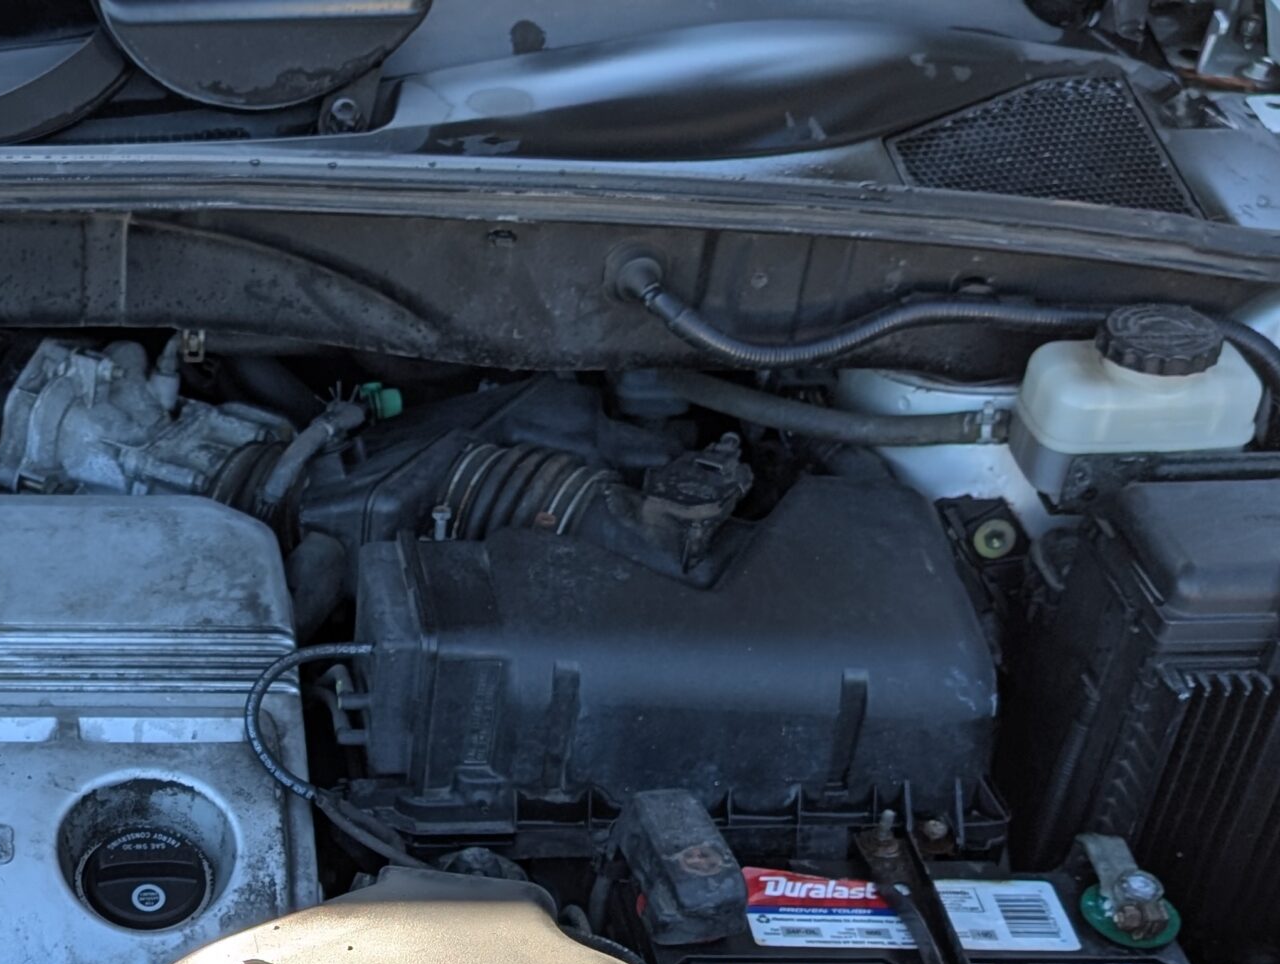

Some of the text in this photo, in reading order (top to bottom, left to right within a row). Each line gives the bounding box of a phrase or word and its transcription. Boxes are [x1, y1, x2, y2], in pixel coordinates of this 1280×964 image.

[152, 833, 181, 849] ENERGY
[759, 876, 878, 899] Duralast
[778, 906, 874, 915] PROVEN TOUGH
